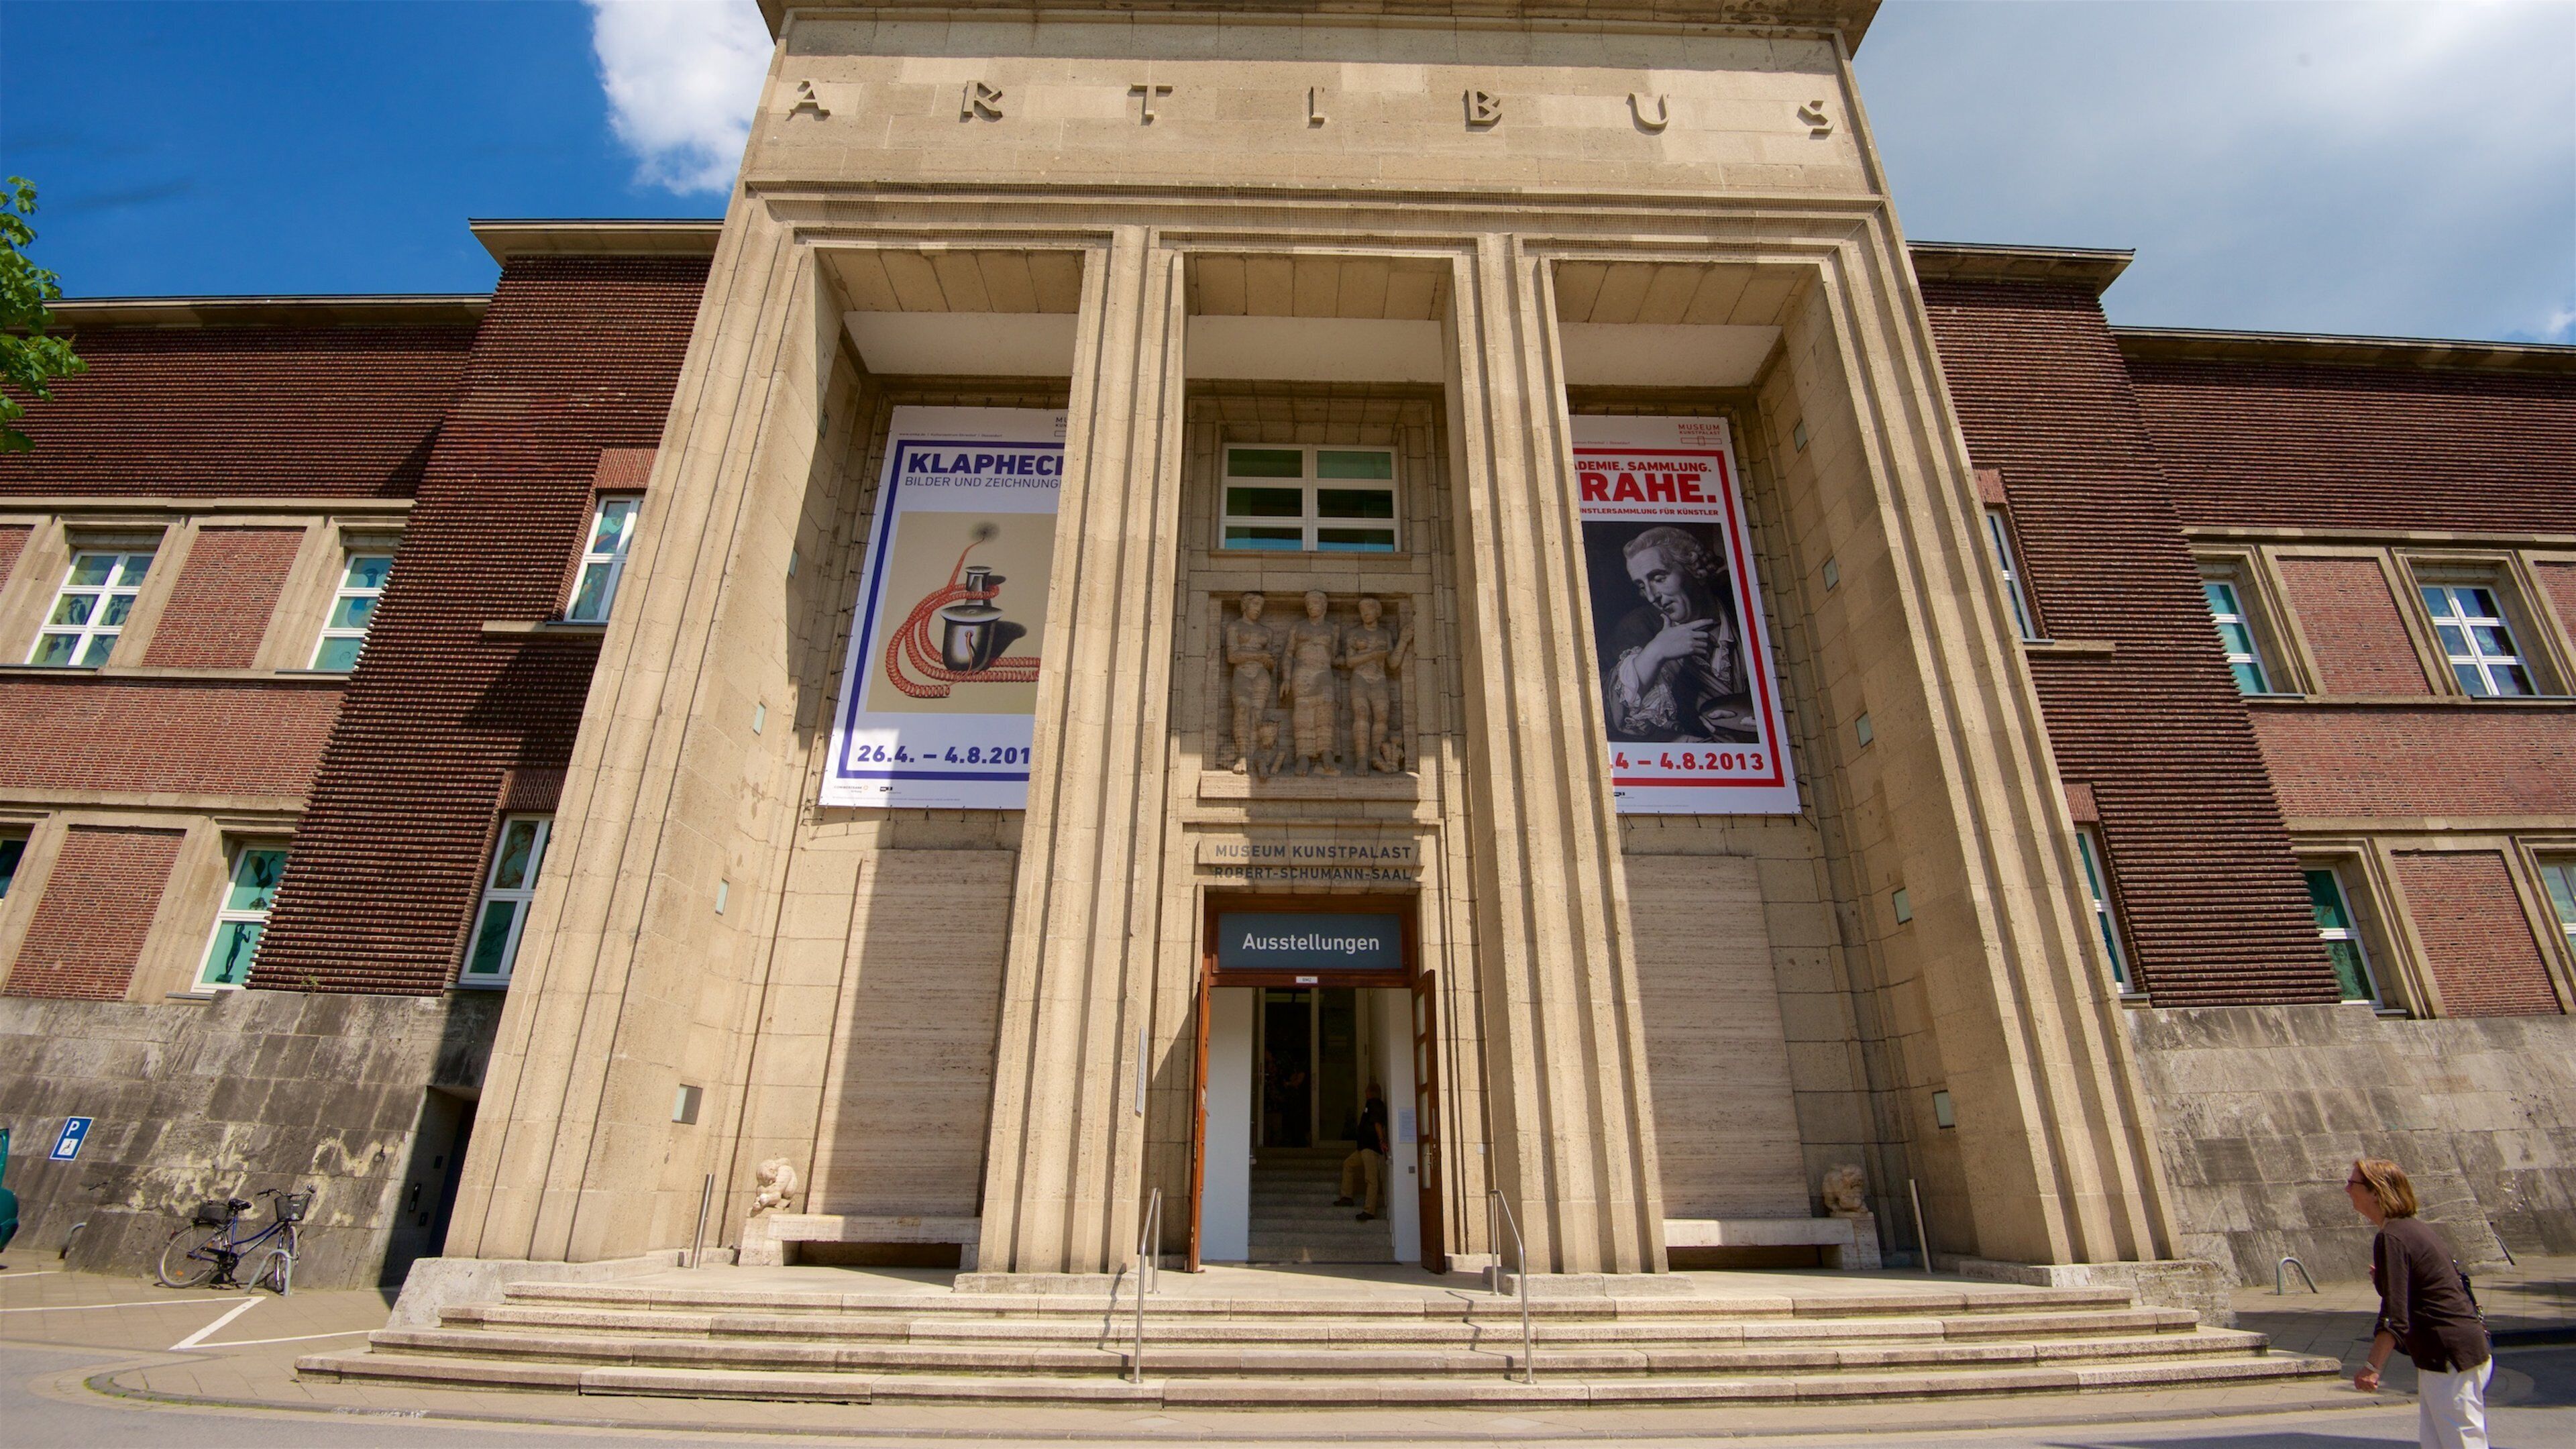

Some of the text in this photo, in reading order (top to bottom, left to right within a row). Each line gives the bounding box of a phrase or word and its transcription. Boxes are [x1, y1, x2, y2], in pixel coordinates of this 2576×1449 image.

[788, 77, 1836, 136] ARTIBUS
[1628, 462, 1712, 472] SAMMLUNG.
[904, 476, 1062, 488] BILDER UND ZEICHNUNG
[1579, 472, 1717, 503] RAHE.
[1660, 507, 1675, 515] FÜR
[1677, 507, 1719, 516] KÜNSTLER
[857, 745, 915, 763] 26.4.
[944, 746, 1030, 765] 4.8.201
[1660, 752, 1764, 771] 4.8.2013
[1215, 845, 1411, 859] MUSEUM KUNSTPALAST
[1214, 867, 1411, 880] ROBERT-SCHUMANN-SAAL
[1242, 932, 1380, 955] Ausstellungen
[66, 1120, 80, 1136] P
